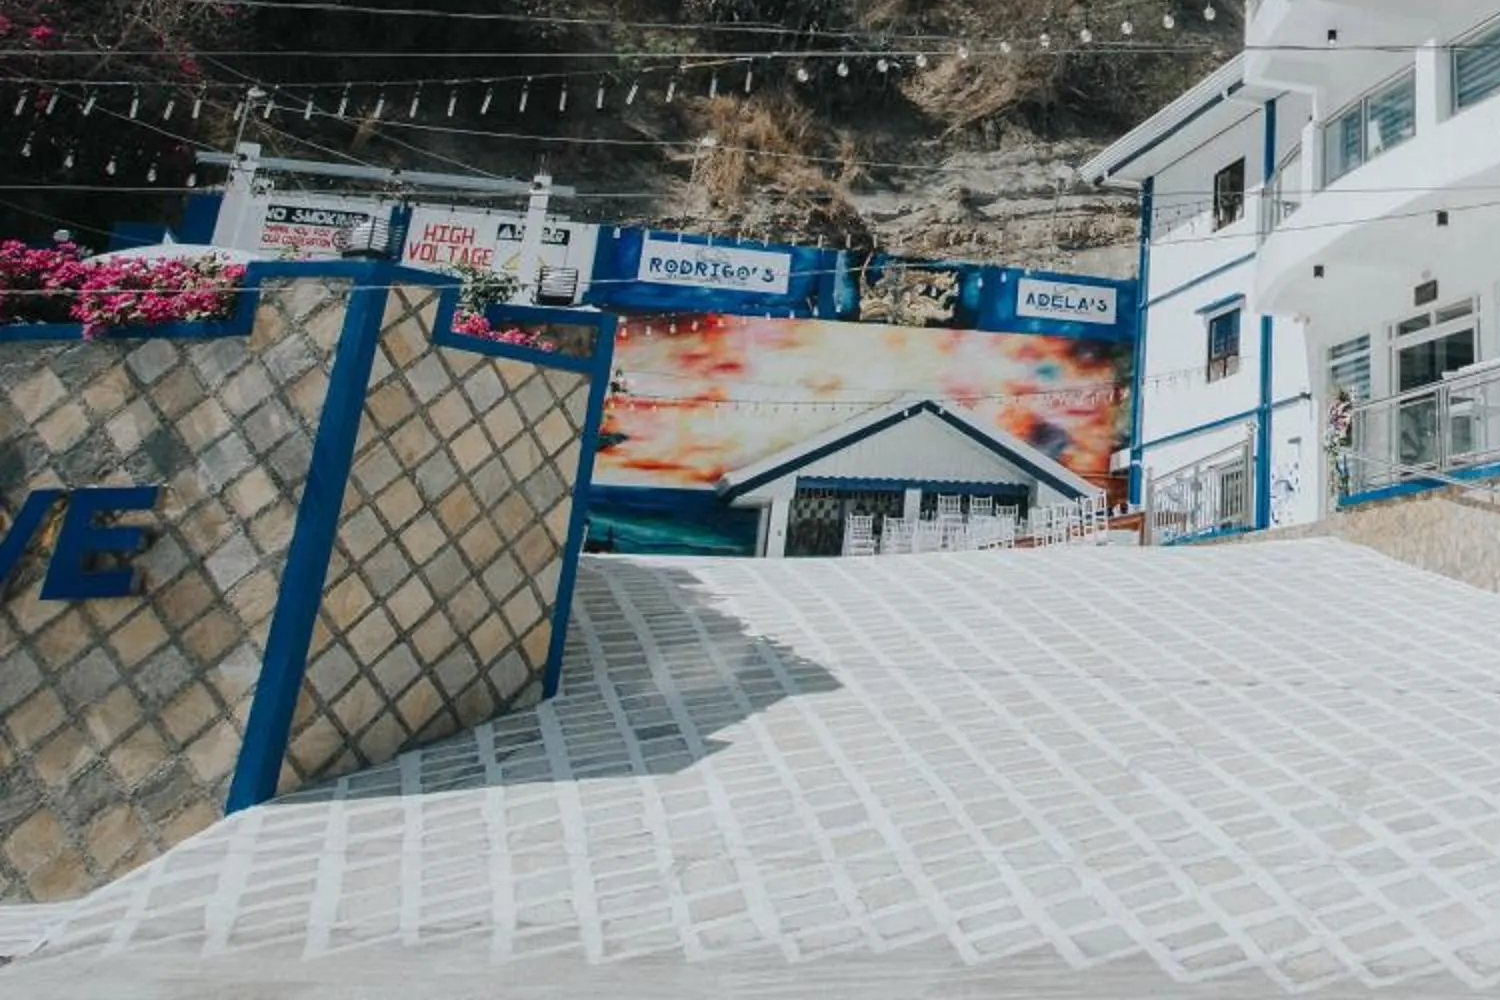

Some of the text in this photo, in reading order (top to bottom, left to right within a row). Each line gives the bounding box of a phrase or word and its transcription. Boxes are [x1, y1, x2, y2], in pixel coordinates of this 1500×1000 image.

[267, 207, 287, 221] NO
[409, 223, 494, 267] HIGH VOLTAGE
[649, 257, 776, 283] RODRIGO'S
[1025, 291, 1108, 313] ADELA'S
